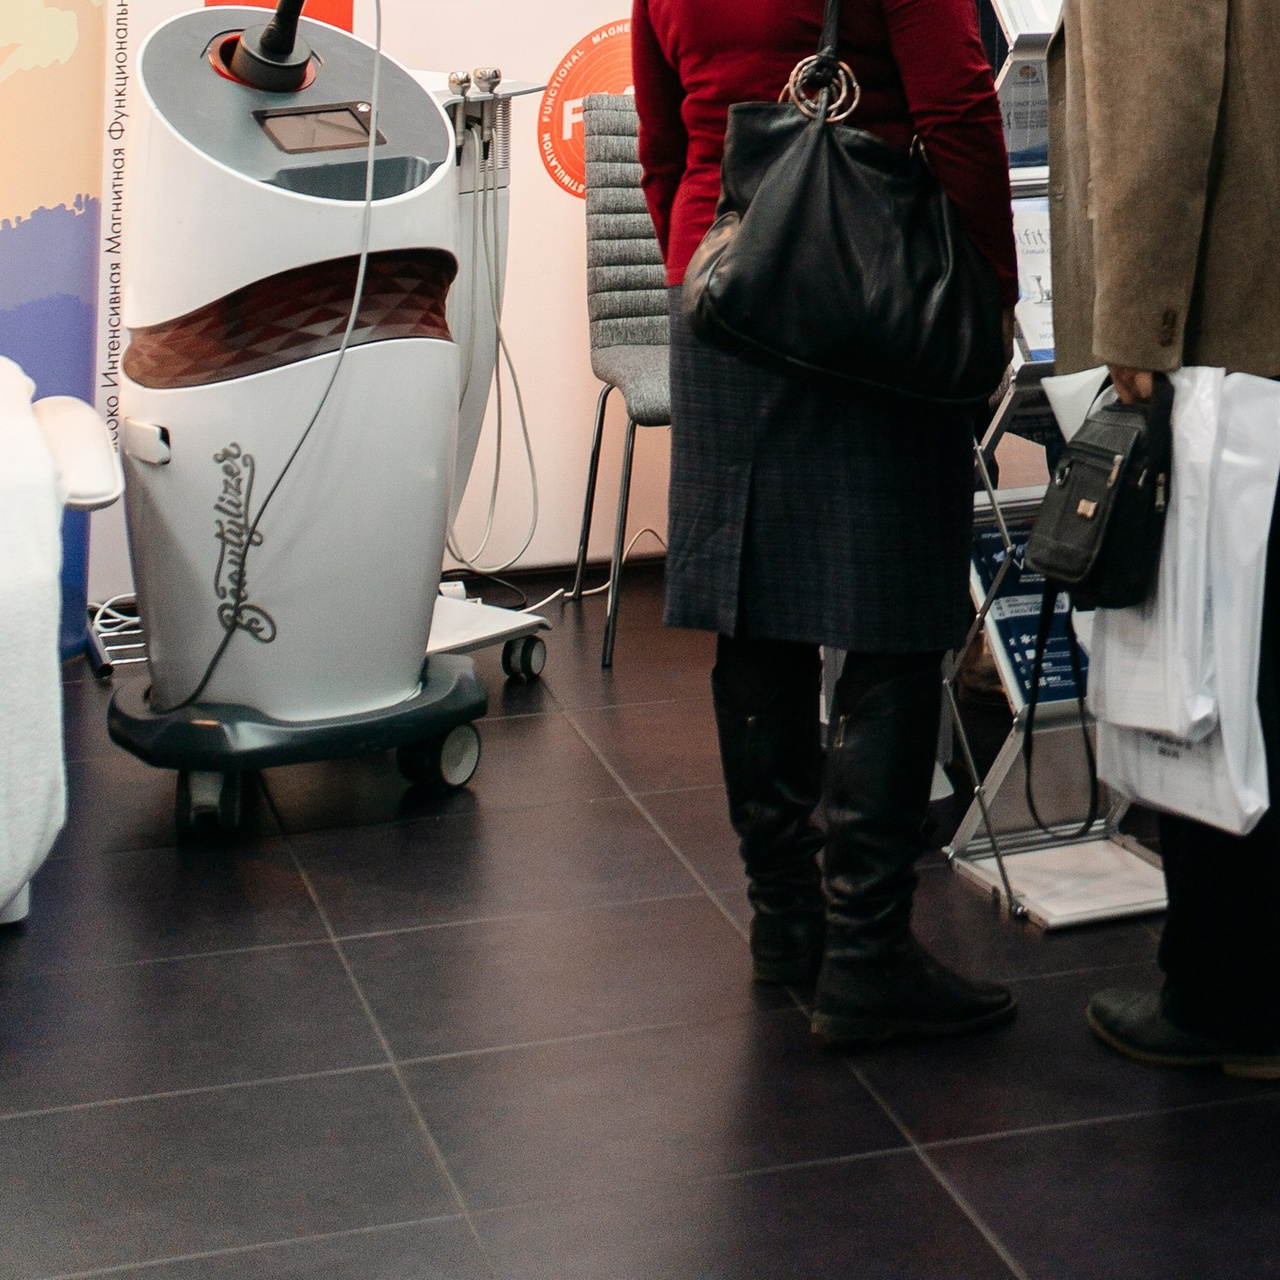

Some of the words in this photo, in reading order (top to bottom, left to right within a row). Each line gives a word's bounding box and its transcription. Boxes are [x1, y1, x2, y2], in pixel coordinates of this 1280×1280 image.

[542, 49, 585, 122] FUNCTIONAL
[104, 147, 125, 255] Магнитная
[542, 133, 586, 193] STIMULATION
[101, 262, 122, 389] Интенсивная
